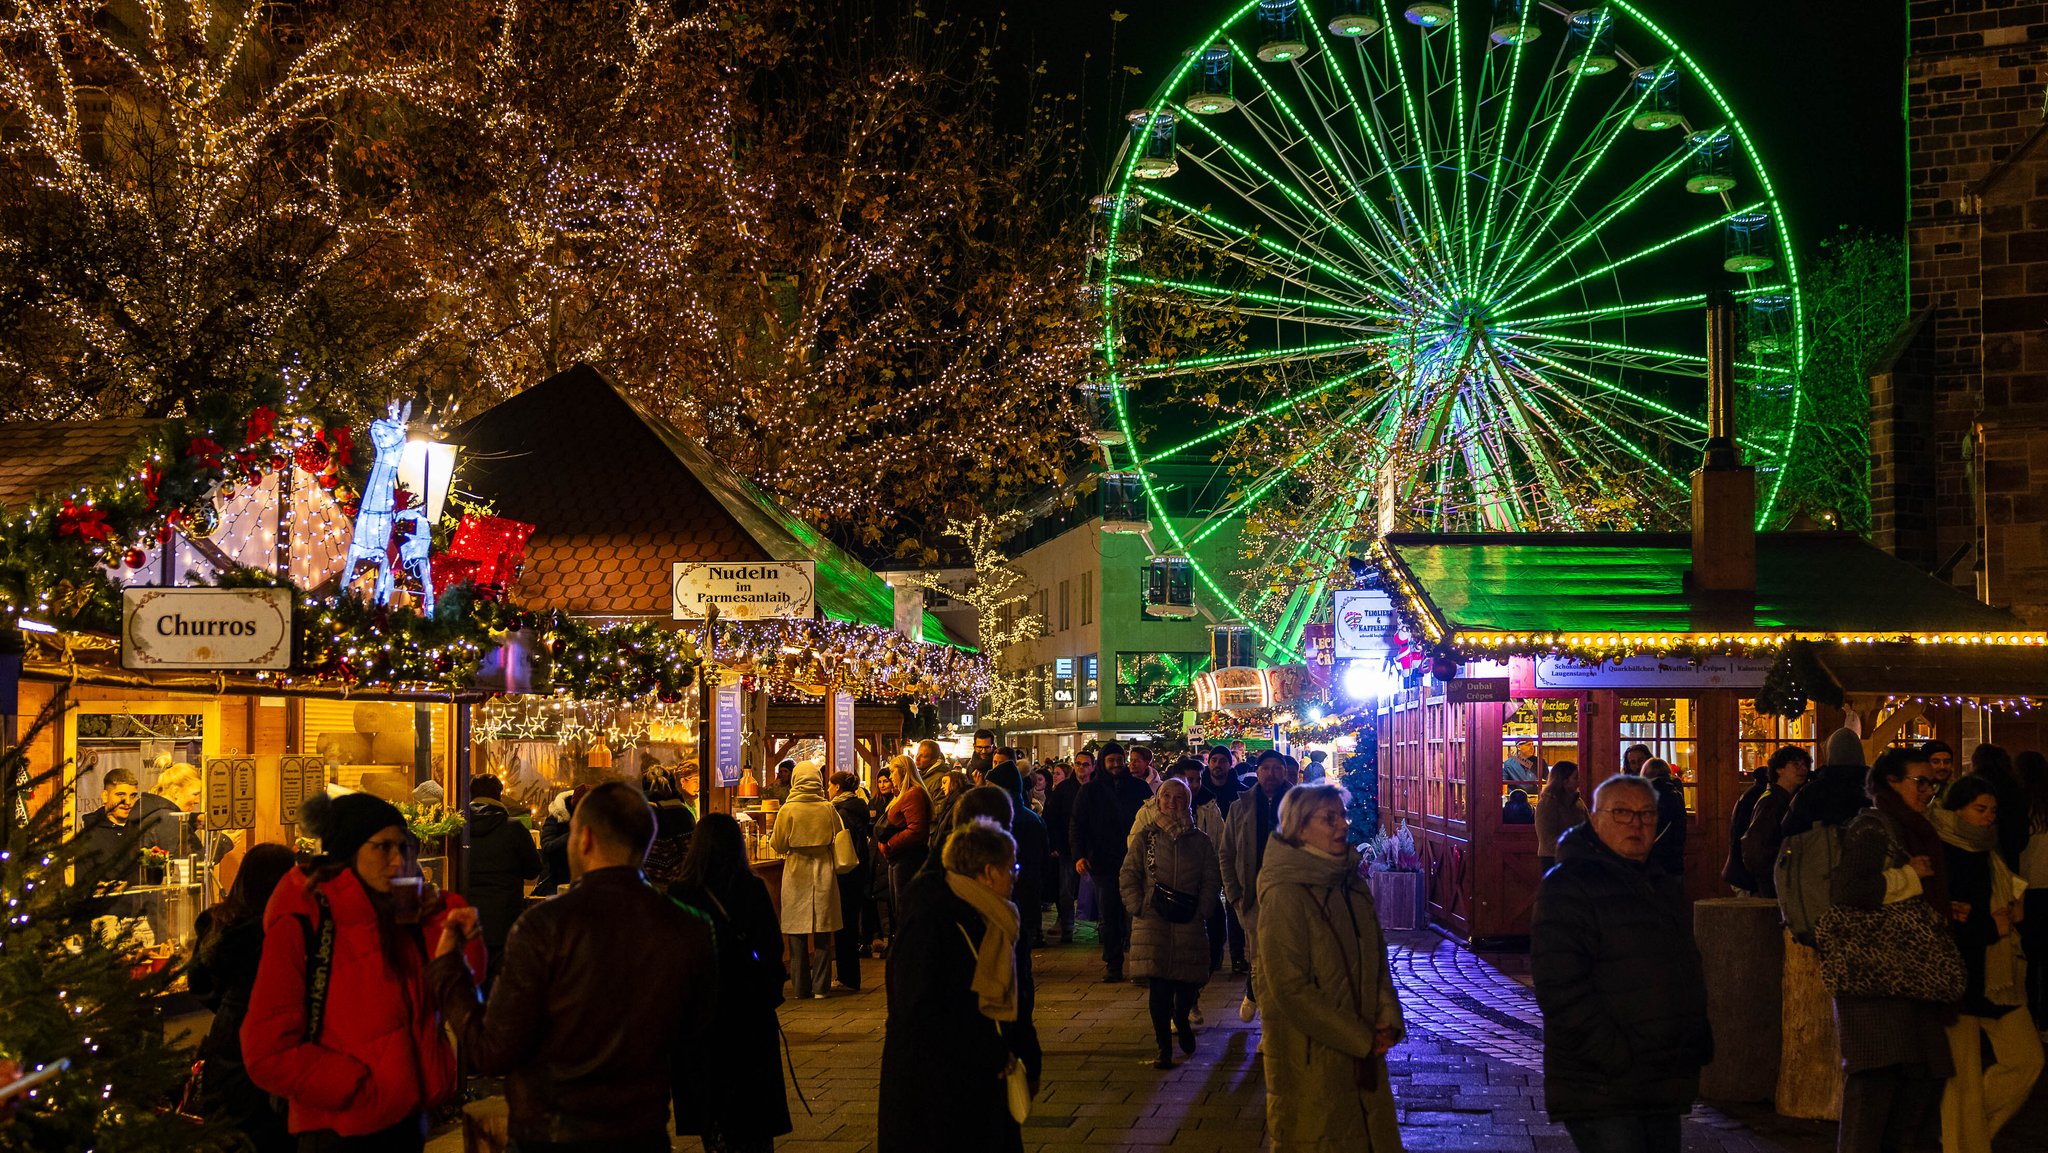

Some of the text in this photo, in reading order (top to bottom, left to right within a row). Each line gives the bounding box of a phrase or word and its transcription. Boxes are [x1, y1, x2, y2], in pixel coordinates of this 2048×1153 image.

[709, 567, 778, 580] Nudeln
[736, 582, 752, 592] im
[697, 592, 791, 603] Parmesanlaib
[156, 613, 257, 636] Churros
[1466, 682, 1493, 690] Dubai
[1466, 692, 1494, 701] Crêpes
[1516, 711, 1534, 723] Tee
[1188, 727, 1203, 735] WC
